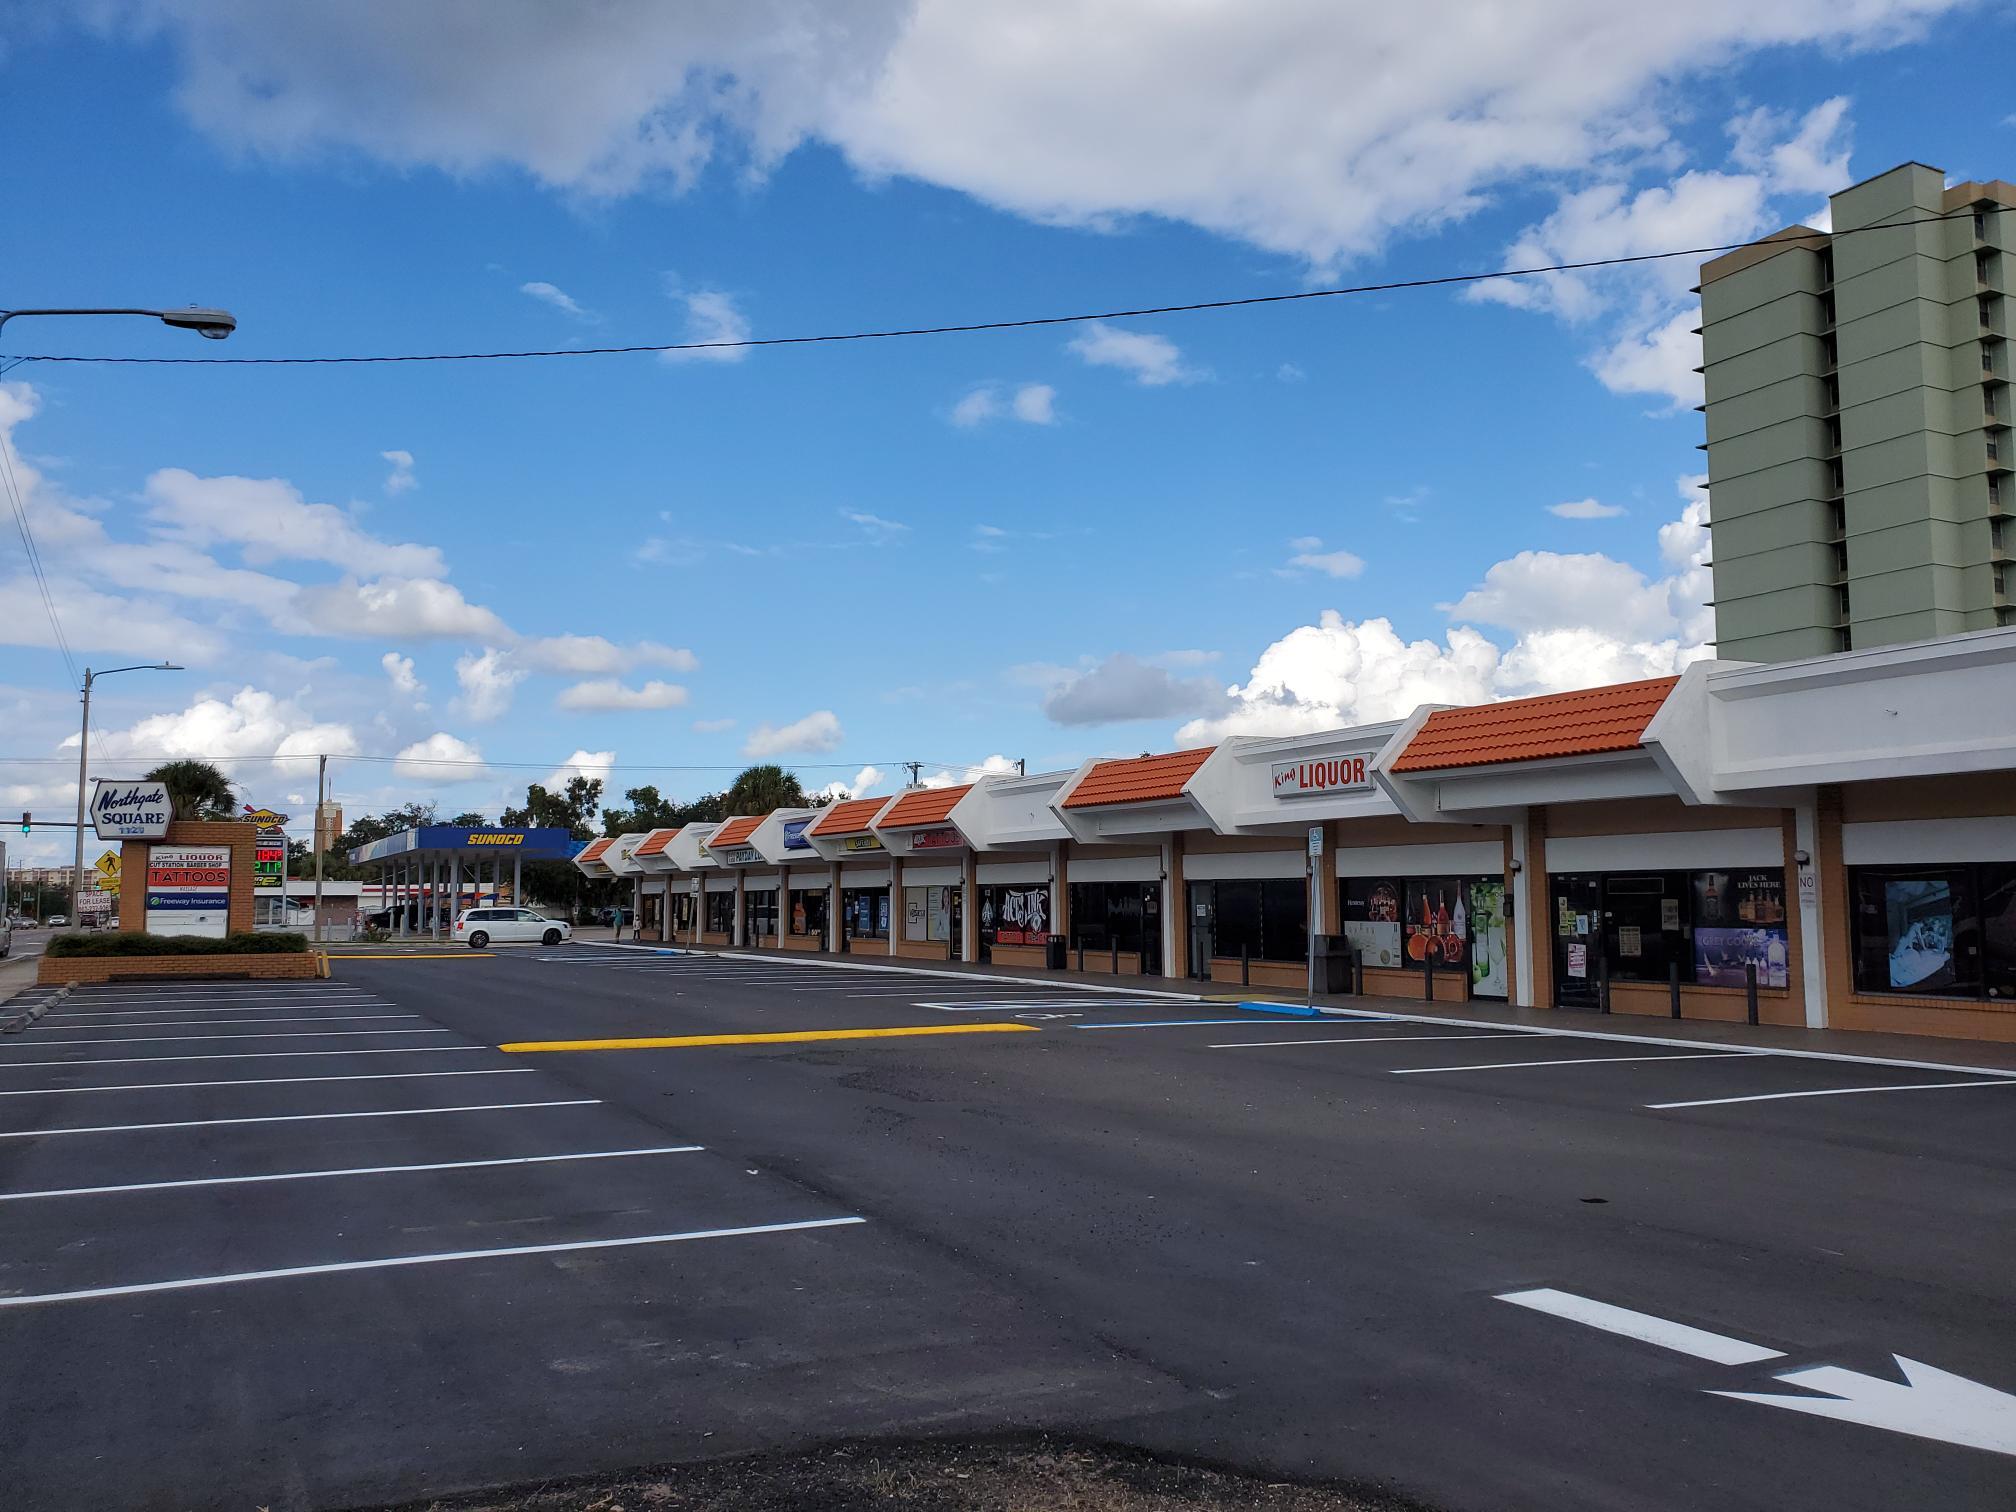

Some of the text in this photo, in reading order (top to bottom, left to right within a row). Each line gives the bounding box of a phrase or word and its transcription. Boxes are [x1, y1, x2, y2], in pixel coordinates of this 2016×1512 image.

[1274, 758, 1365, 789] King LIQUOR
[97, 786, 164, 812] Northgate
[101, 812, 165, 825] SQUARE
[243, 815, 286, 824] SUNOCO
[467, 834, 525, 845] SUNOCO
[151, 871, 226, 882] TATTOOS
[1749, 874, 1768, 882] JACK
[1799, 877, 1814, 888] NO
[92, 897, 111, 905] LEASE
[160, 897, 190, 906] Freeway
